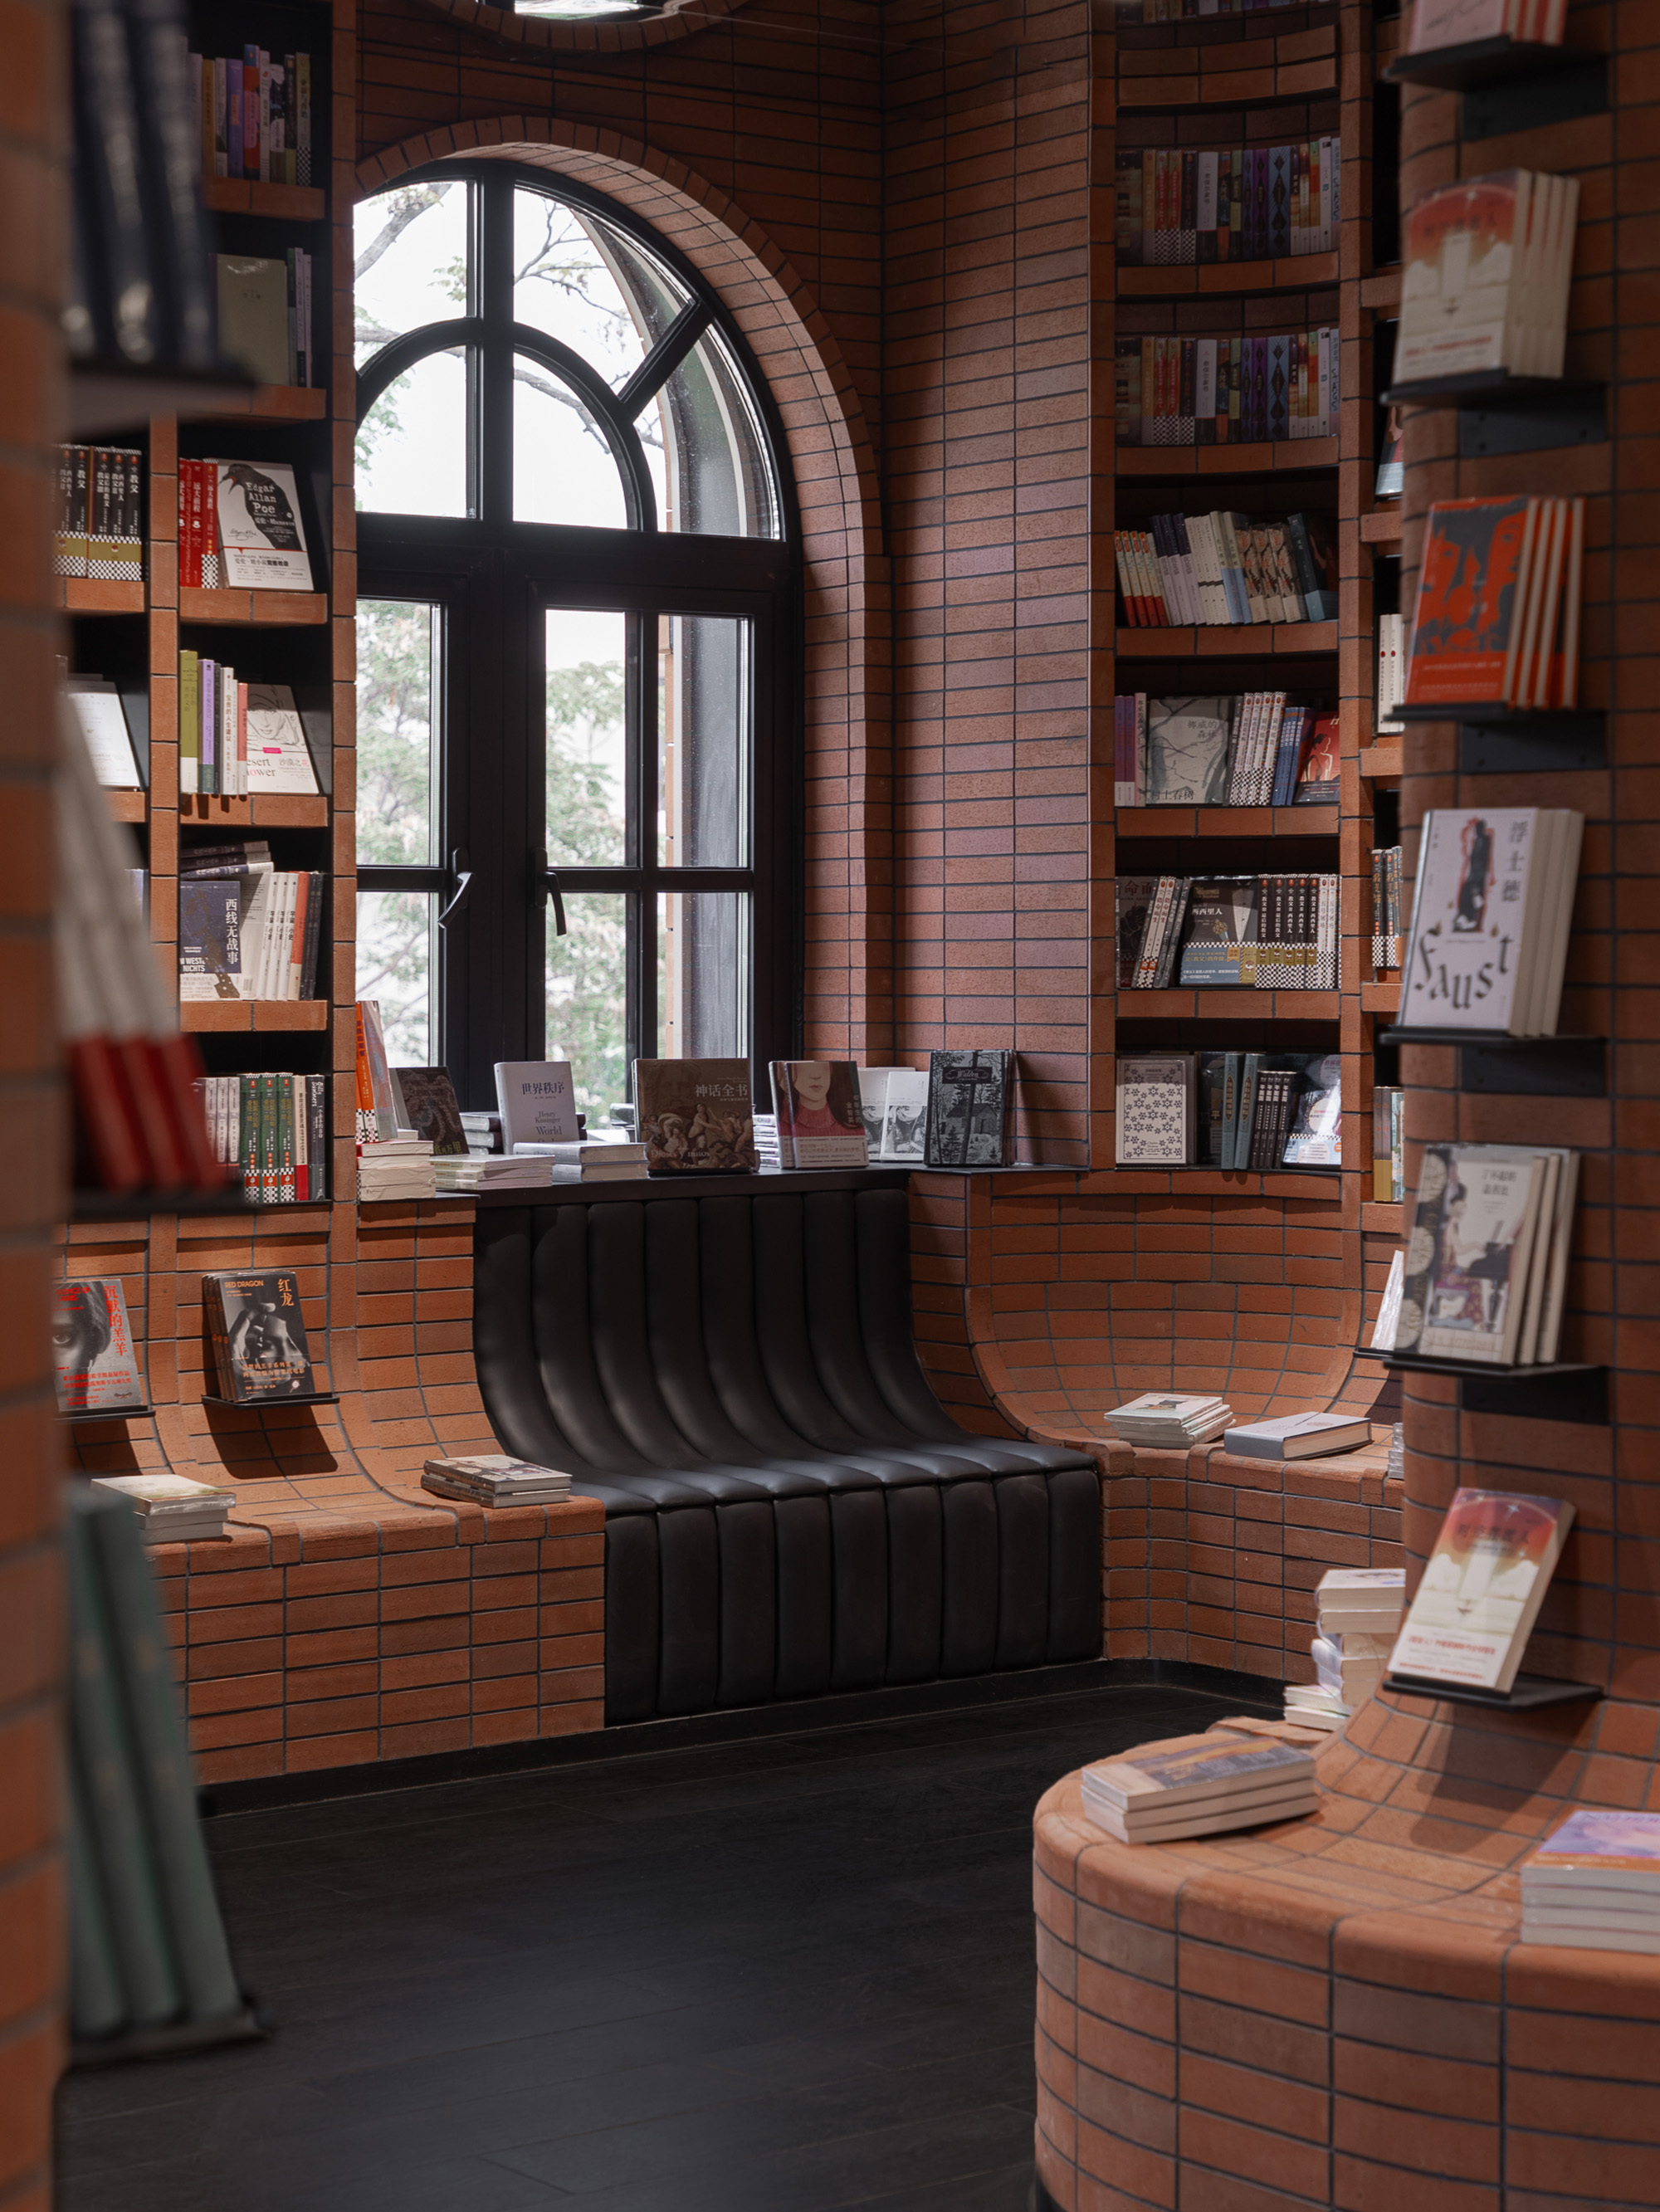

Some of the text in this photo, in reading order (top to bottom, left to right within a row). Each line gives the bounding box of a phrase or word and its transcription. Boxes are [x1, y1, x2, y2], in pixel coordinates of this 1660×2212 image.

[246, 482, 276, 494] Edgar
[248, 492, 277, 503] Allan
[252, 502, 276, 515] Poe
[1198, 730, 1217, 740] 森林
[247, 759, 271, 767] esert
[1150, 789, 1194, 800] 村上春树
[1192, 907, 1223, 916] 西西里人
[225, 898, 239, 965] 西线无战事
[183, 964, 206, 973] NICHTS
[522, 1082, 564, 1095] 世界秩序
[695, 1083, 749, 1097] 神话全书
[536, 1126, 563, 1135] World
[434, 1141, 462, 1155] 底两万里
[651, 1150, 677, 1158] Dioses
[237, 1279, 264, 1288] DRAGON
[277, 1278, 295, 1307] 红龙
[104, 1285, 128, 1356] 沉默的羔羊
